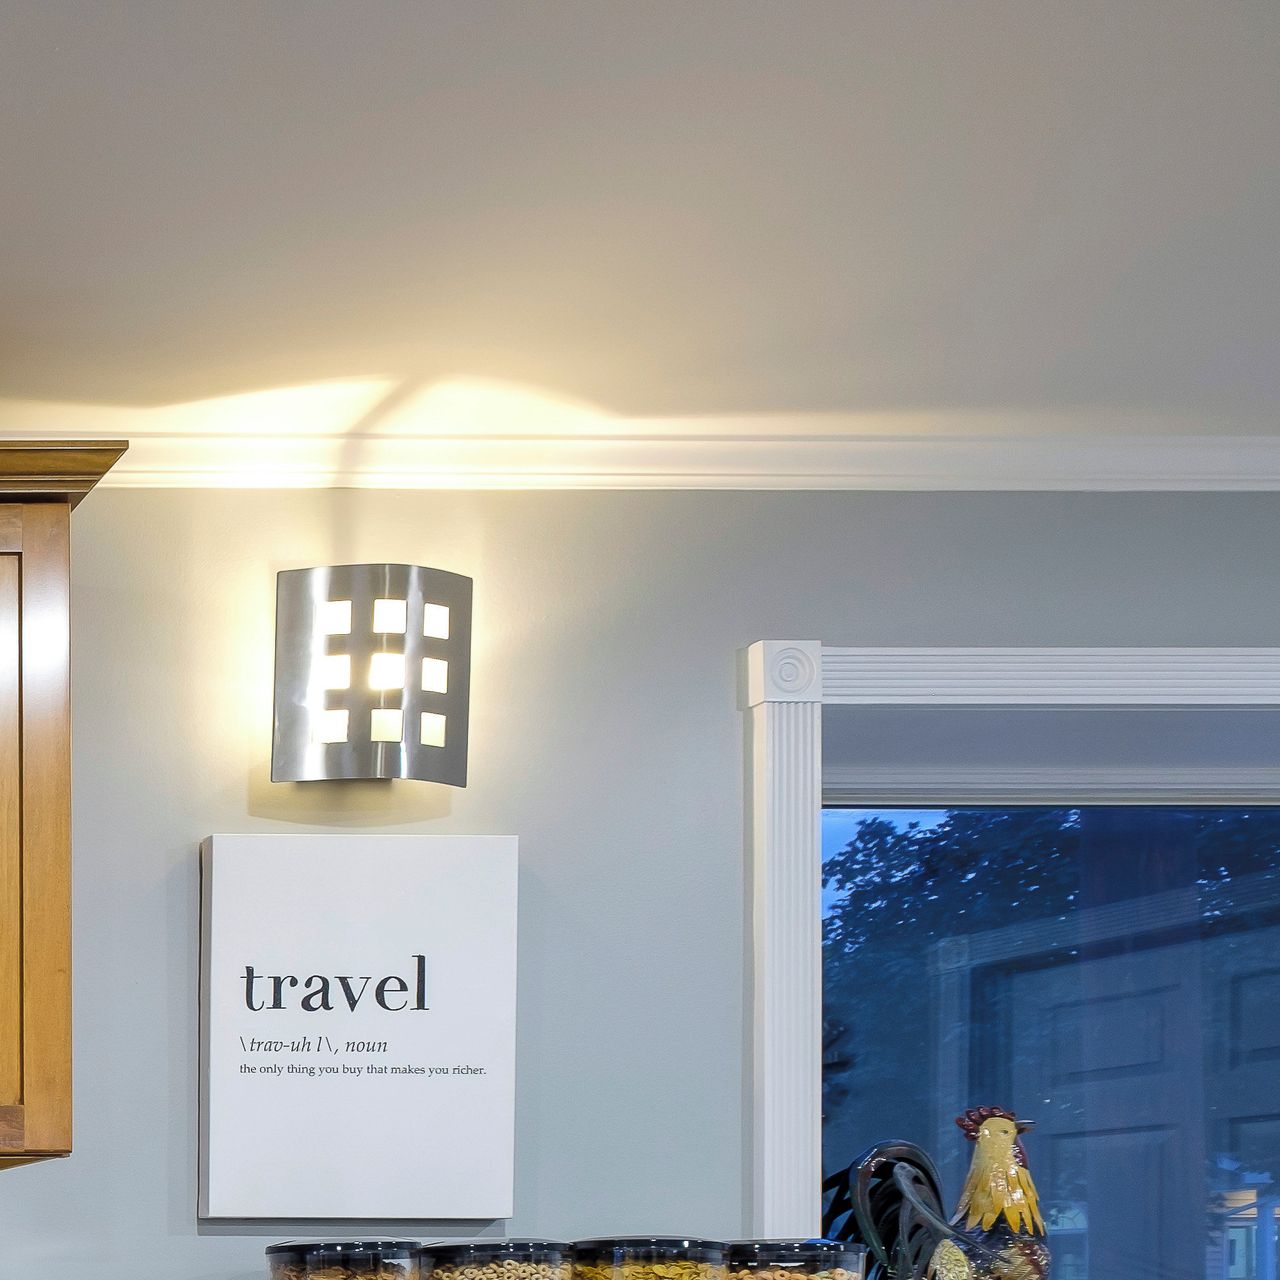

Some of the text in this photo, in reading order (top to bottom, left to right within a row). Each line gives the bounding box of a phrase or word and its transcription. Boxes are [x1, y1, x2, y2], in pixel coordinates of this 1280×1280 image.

[240, 954, 430, 1013] travel
[345, 1039, 388, 1053] noun
[240, 1063, 487, 1077] the only thing you buy that makes you richer.
